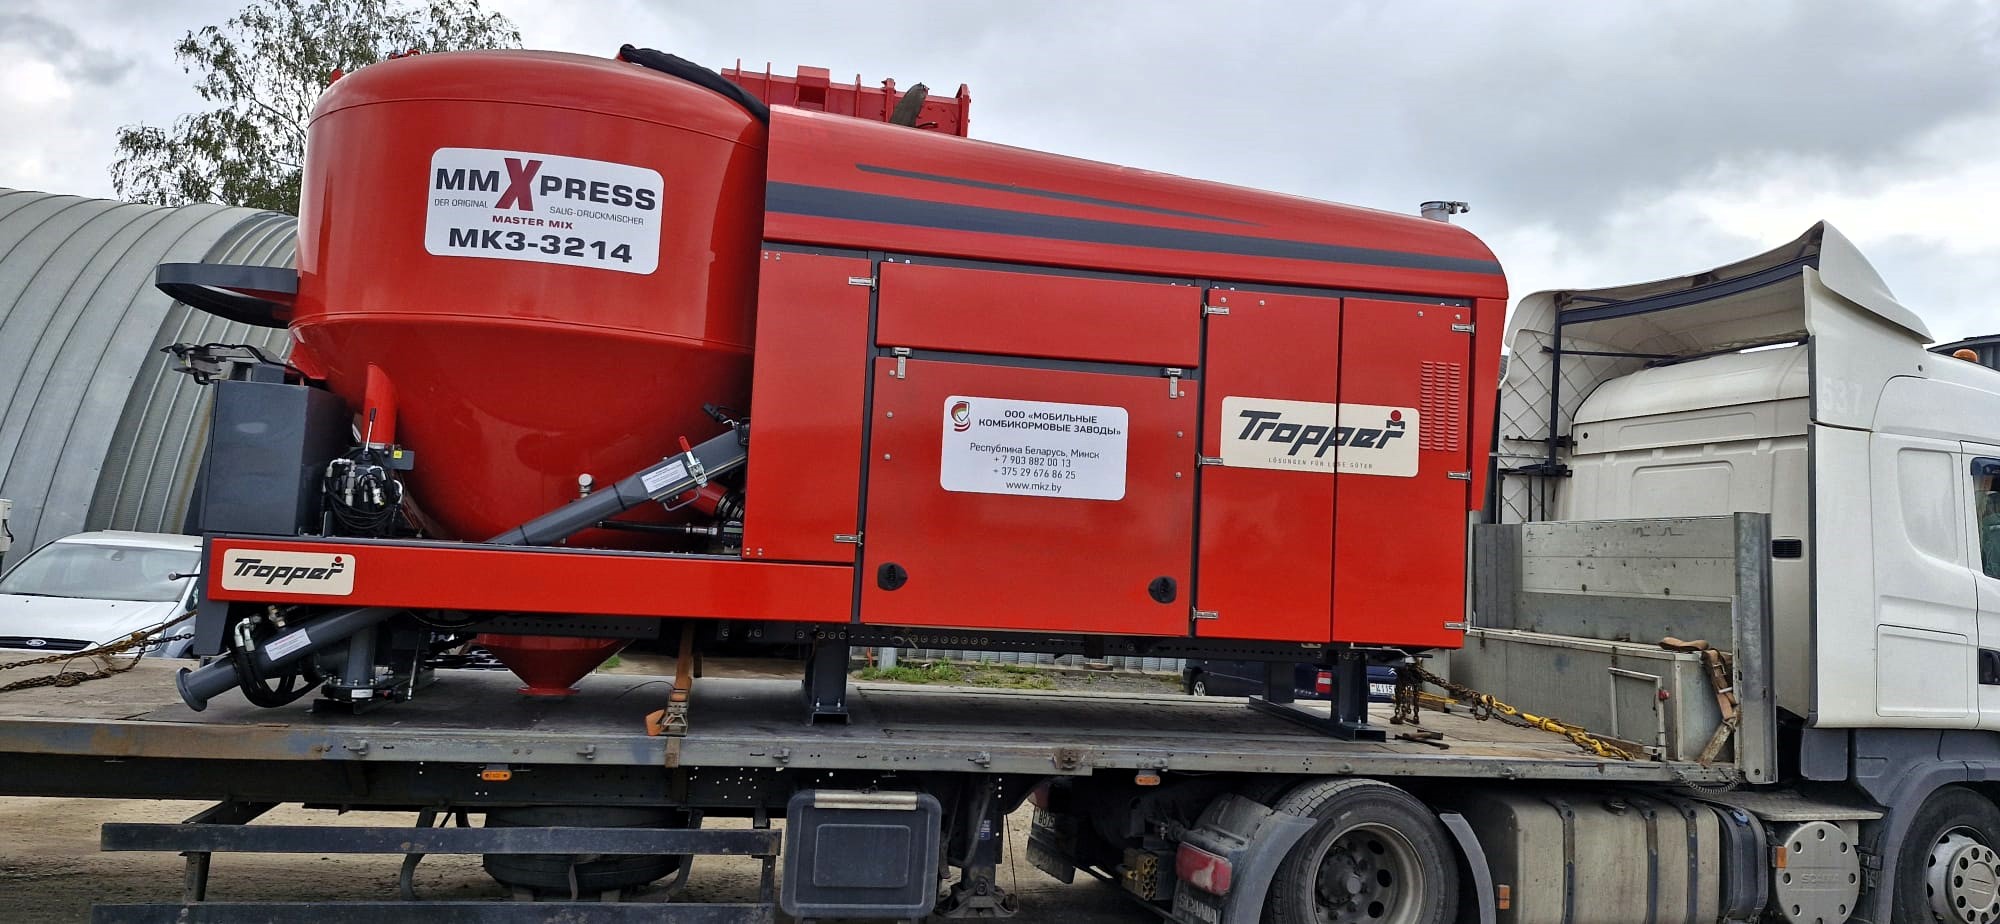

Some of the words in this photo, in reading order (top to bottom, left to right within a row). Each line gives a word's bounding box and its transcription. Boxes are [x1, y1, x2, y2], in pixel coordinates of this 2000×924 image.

[434, 199, 450, 207] DER
[451, 199, 488, 209] ORIGINAL
[492, 215, 544, 227] MASTER
[548, 219, 573, 230] MIX
[549, 206, 644, 226] SAUG-DRUCKMISCHER
[448, 227, 633, 264] MK3-3214
[1004, 410, 1026, 419] ООО
[1028, 411, 1098, 424] «МОБИЛЬНЫЕ
[978, 418, 1071, 432] КОМБИКОРМОВЫЕ
[1073, 425, 1121, 436] ЗАВОДЫ»
[1238, 409, 1405, 458] Tropper
[969, 442, 1023, 455] Республика
[1025, 446, 1068, 458] Беларусь,
[1071, 449, 1100, 459] Минск
[1002, 456, 1007, 464] 7
[1010, 456, 1026, 465] 903
[1028, 457, 1044, 466] 882
[1047, 458, 1058, 467] 00
[1061, 459, 1071, 468] 13
[1327, 461, 1346, 469] LSE
[1001, 467, 1018, 476] 375
[1020, 468, 1031, 477] 29
[1033, 469, 1050, 478] 676
[1052, 470, 1063, 479] 86
[1065, 470, 1076, 480] 25
[1006, 481, 1062, 493] www.mkz.by
[233, 556, 345, 586] Tropper
